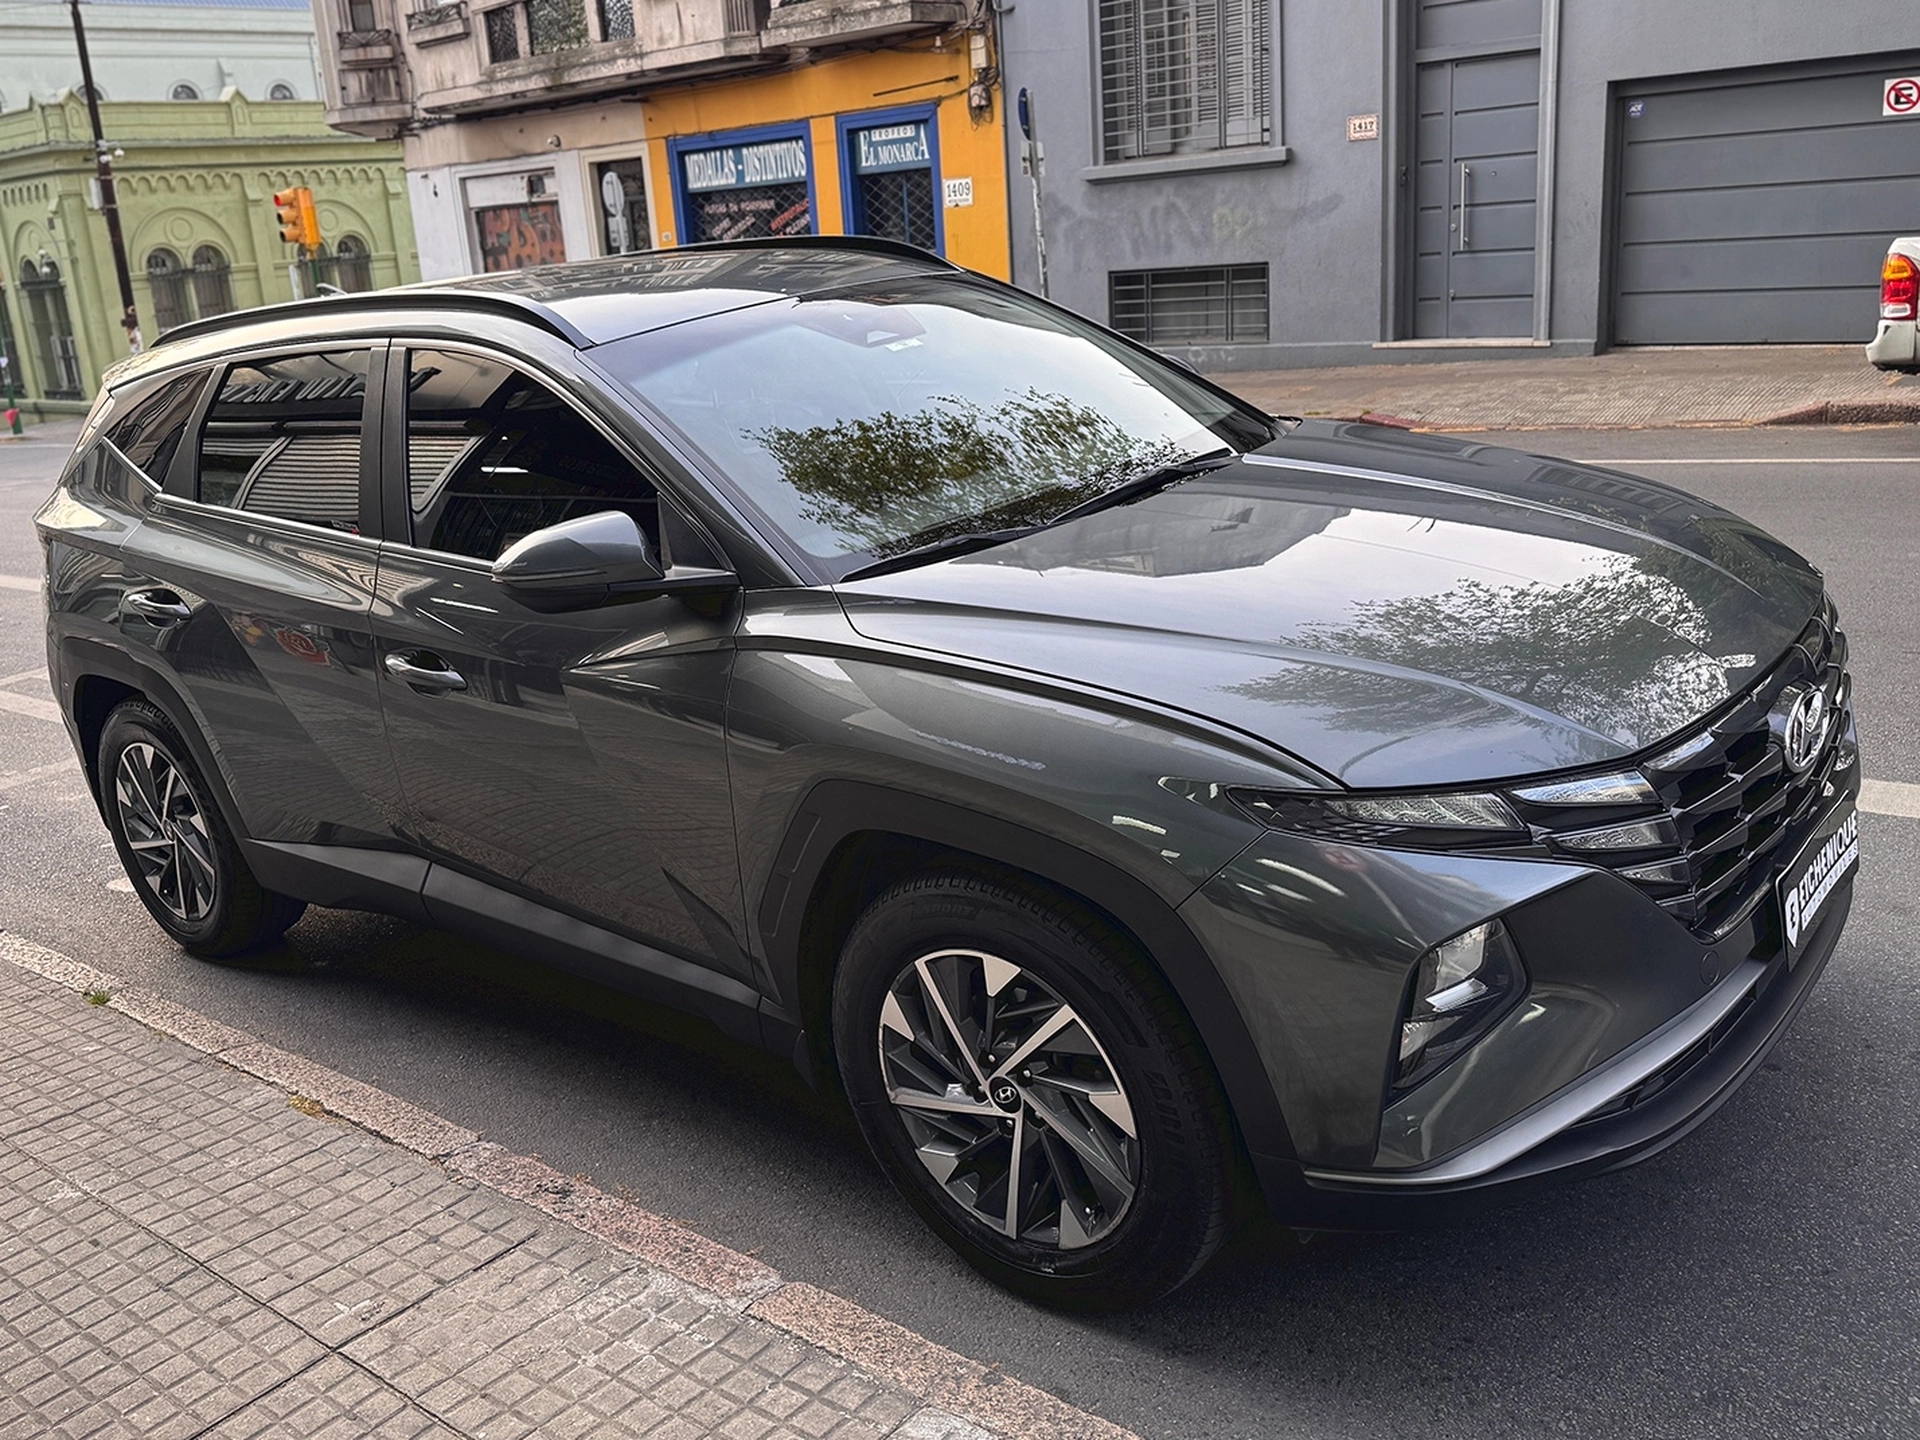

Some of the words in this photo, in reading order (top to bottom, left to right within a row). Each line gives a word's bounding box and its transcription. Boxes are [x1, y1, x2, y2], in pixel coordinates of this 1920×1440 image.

[873, 126, 915, 139] TROFEOS
[1352, 120, 1375, 131] 1417
[878, 124, 930, 165] MONARCA
[684, 148, 737, 189] MEDALLAS
[741, 139, 807, 183] DISTINTIVOS
[946, 181, 971, 198] 1409
[1799, 809, 1857, 910] ETCHENIQUE
